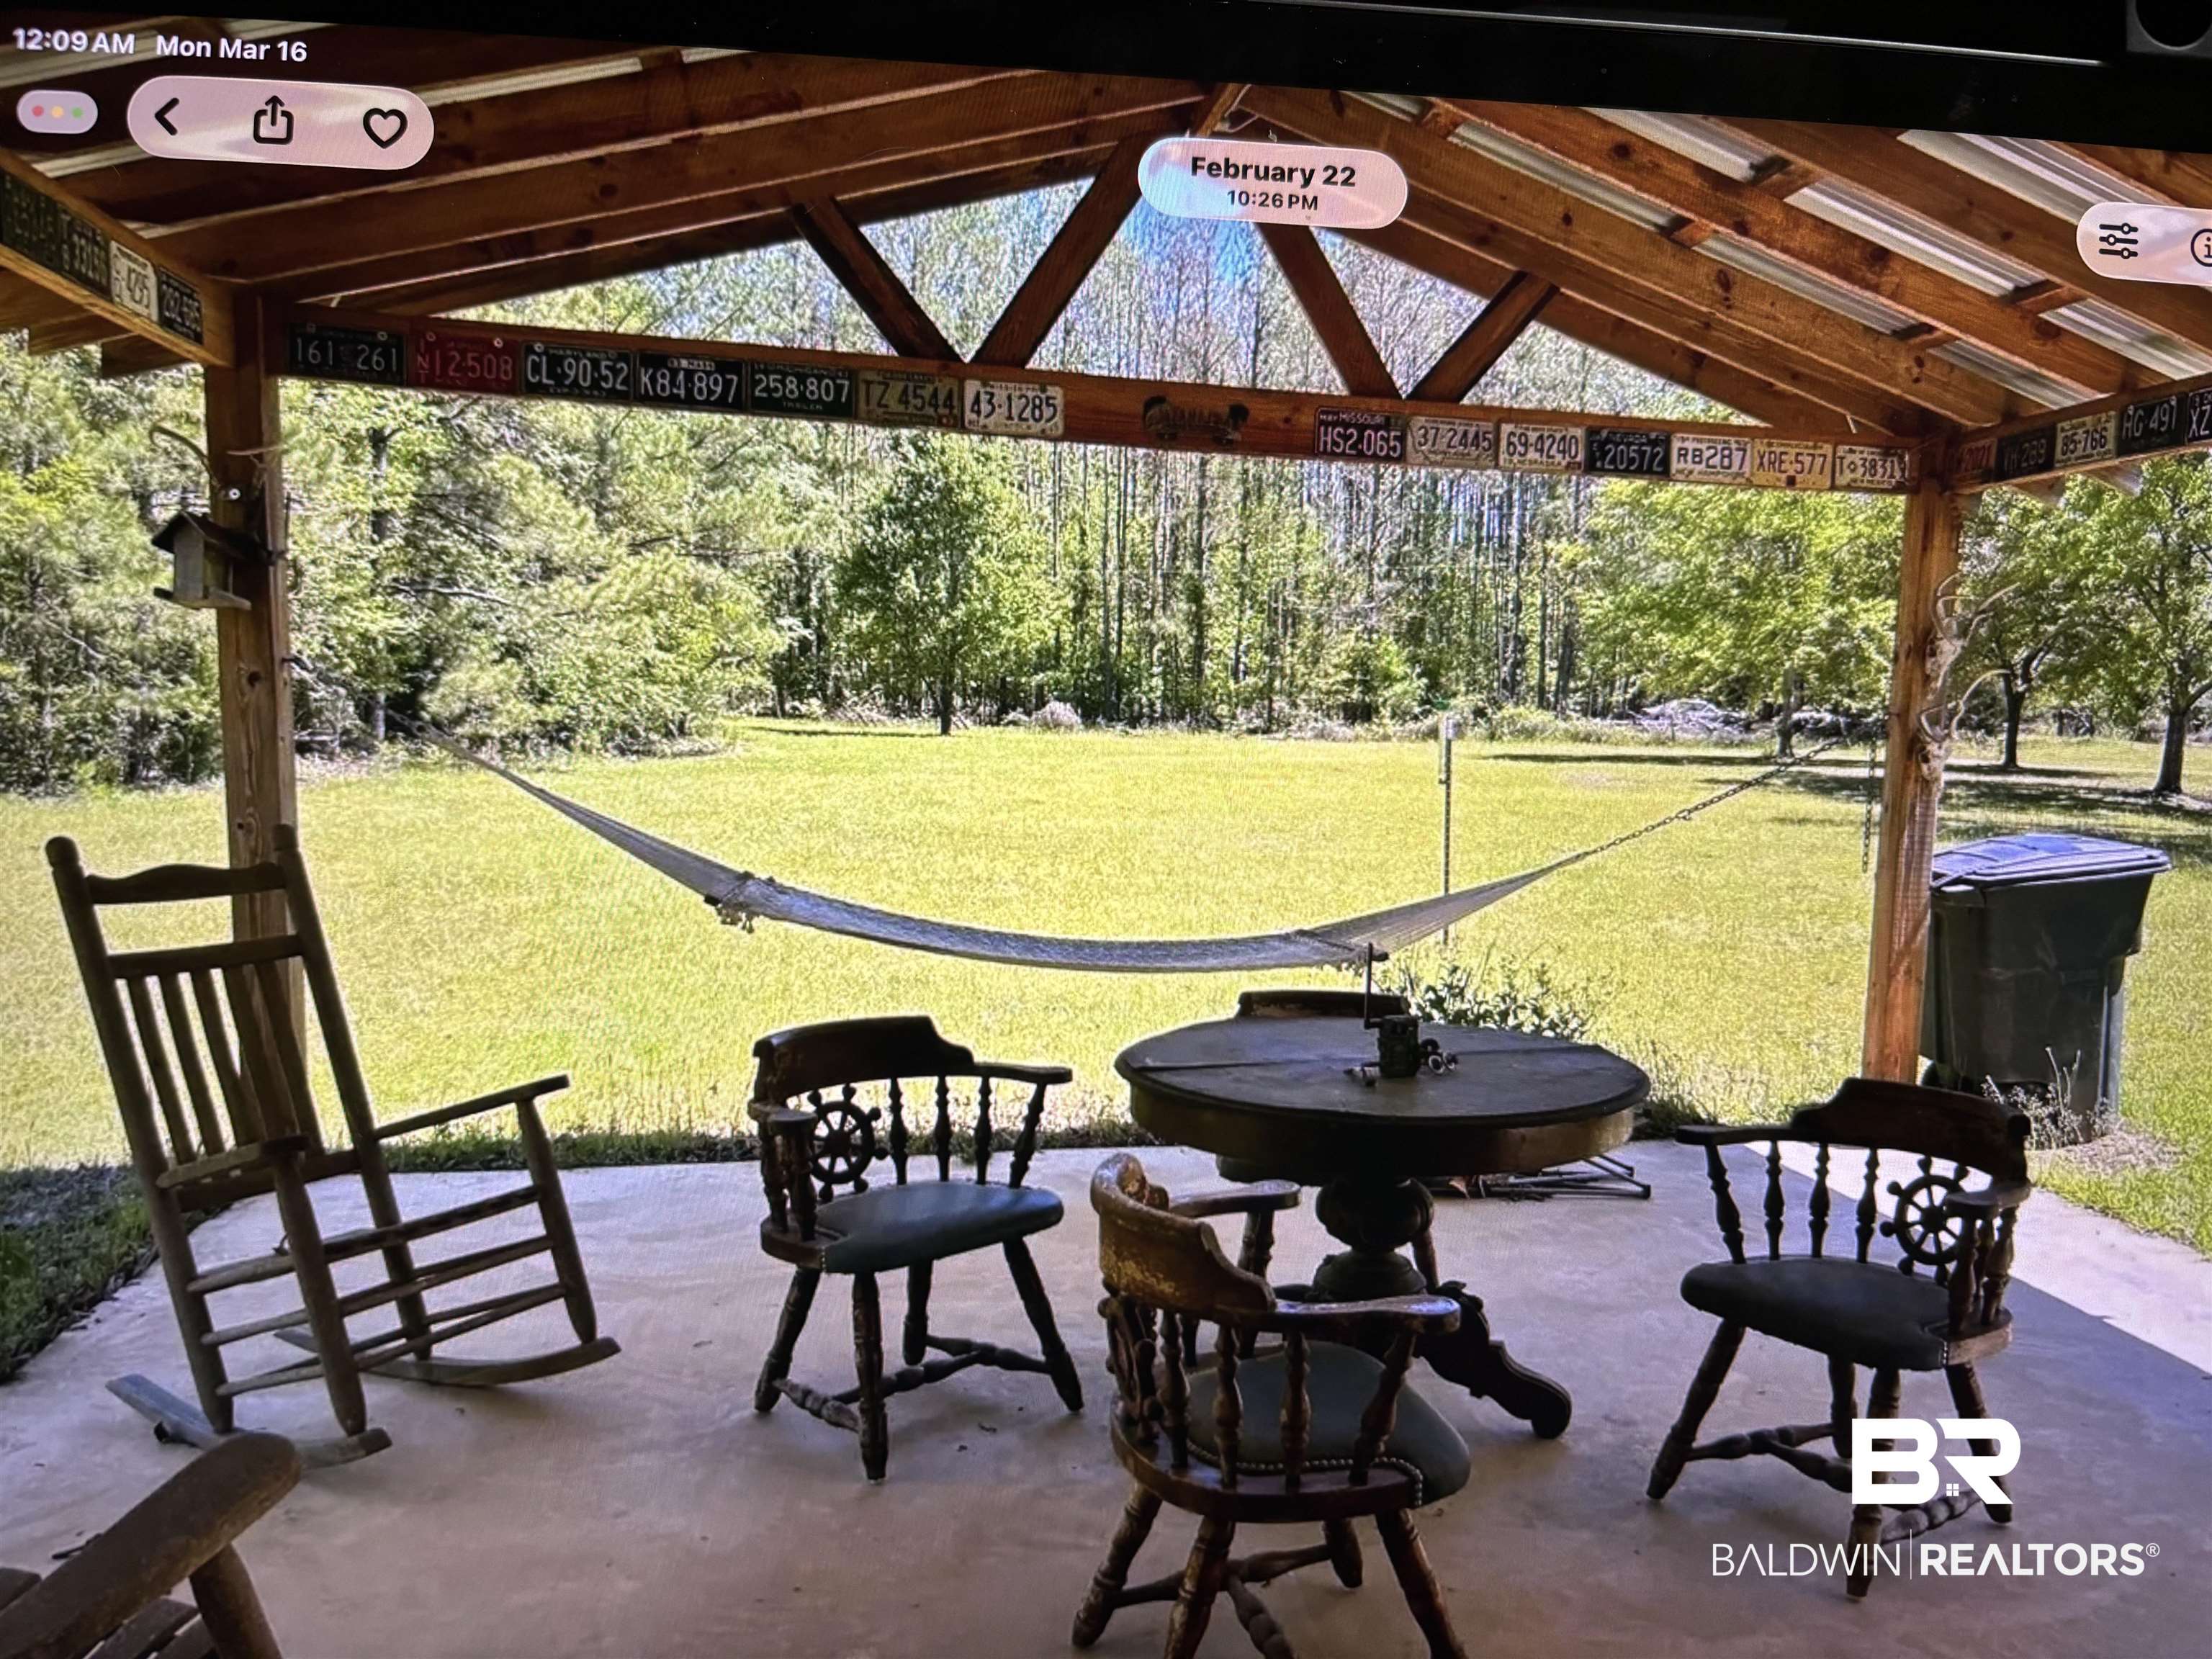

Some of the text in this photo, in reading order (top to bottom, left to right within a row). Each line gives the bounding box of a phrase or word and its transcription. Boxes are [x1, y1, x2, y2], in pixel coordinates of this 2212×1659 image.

[12, 28, 307, 63] 12:09 AM Mon Mar 16
[1190, 156, 1357, 189] February 22
[1227, 189, 1318, 211] 10:26 PM
[296, 336, 397, 373] 161 261
[1506, 431, 1579, 460] 69-4240
[1603, 443, 1665, 472] 20572
